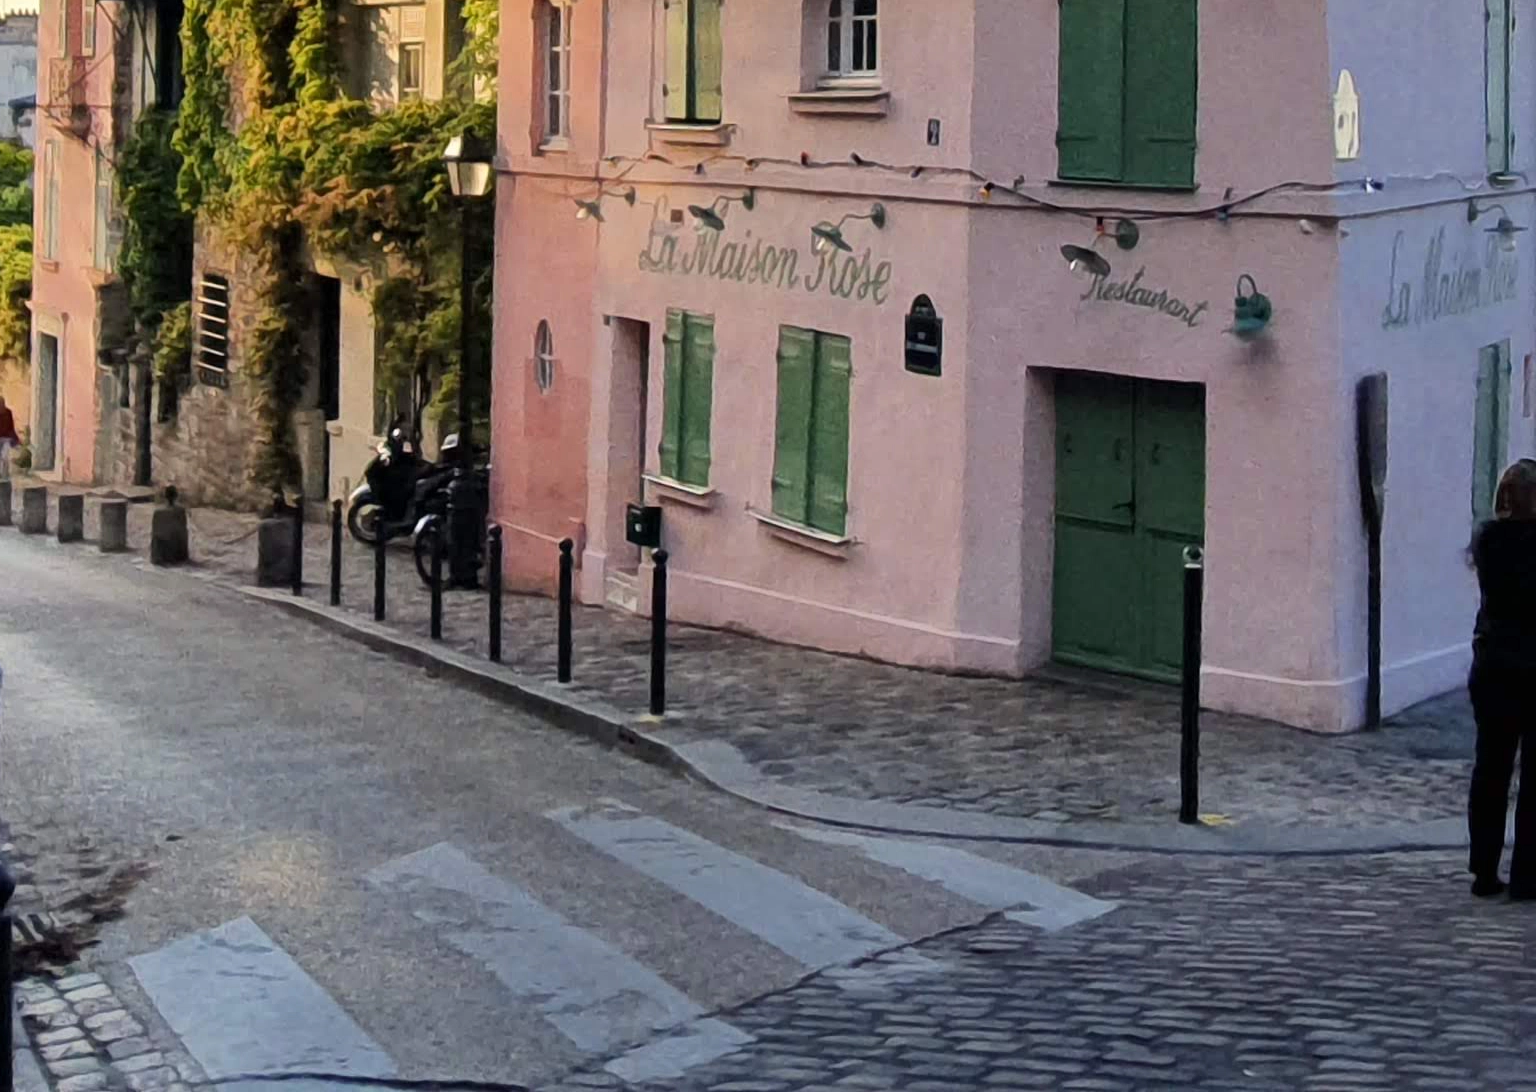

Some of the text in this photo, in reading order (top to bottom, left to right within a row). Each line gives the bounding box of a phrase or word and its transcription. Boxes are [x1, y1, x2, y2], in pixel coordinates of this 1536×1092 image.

[639, 194, 893, 306] La Maison Rose
[1080, 265, 1210, 328] Restaurant
[1381, 229, 1411, 332] La
